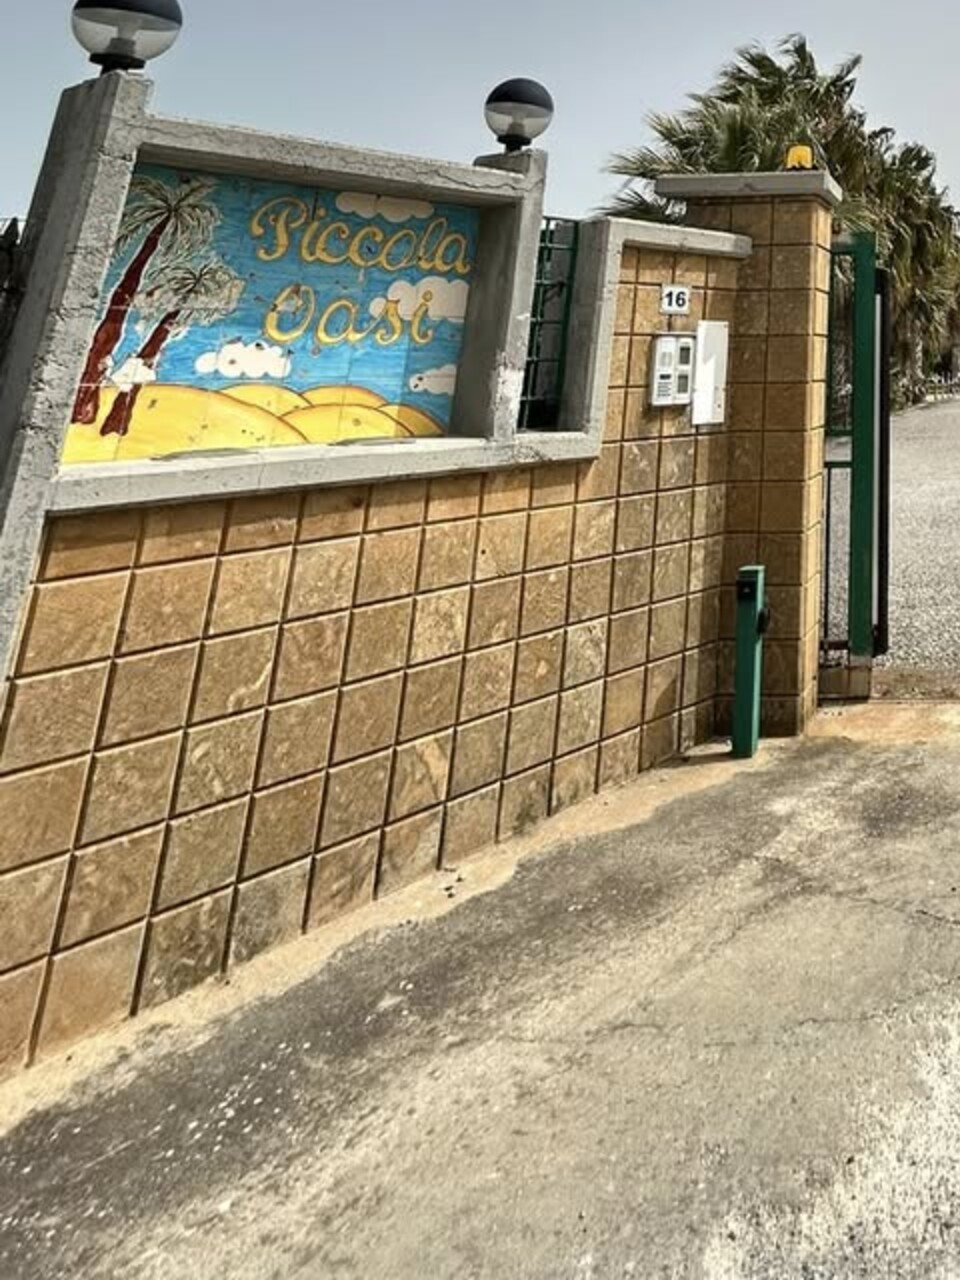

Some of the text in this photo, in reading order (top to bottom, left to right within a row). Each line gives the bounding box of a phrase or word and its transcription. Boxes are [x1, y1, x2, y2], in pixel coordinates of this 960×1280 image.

[251, 196, 471, 273] Piccola
[265, 284, 436, 345] Oasi
[665, 291, 687, 308] 16
